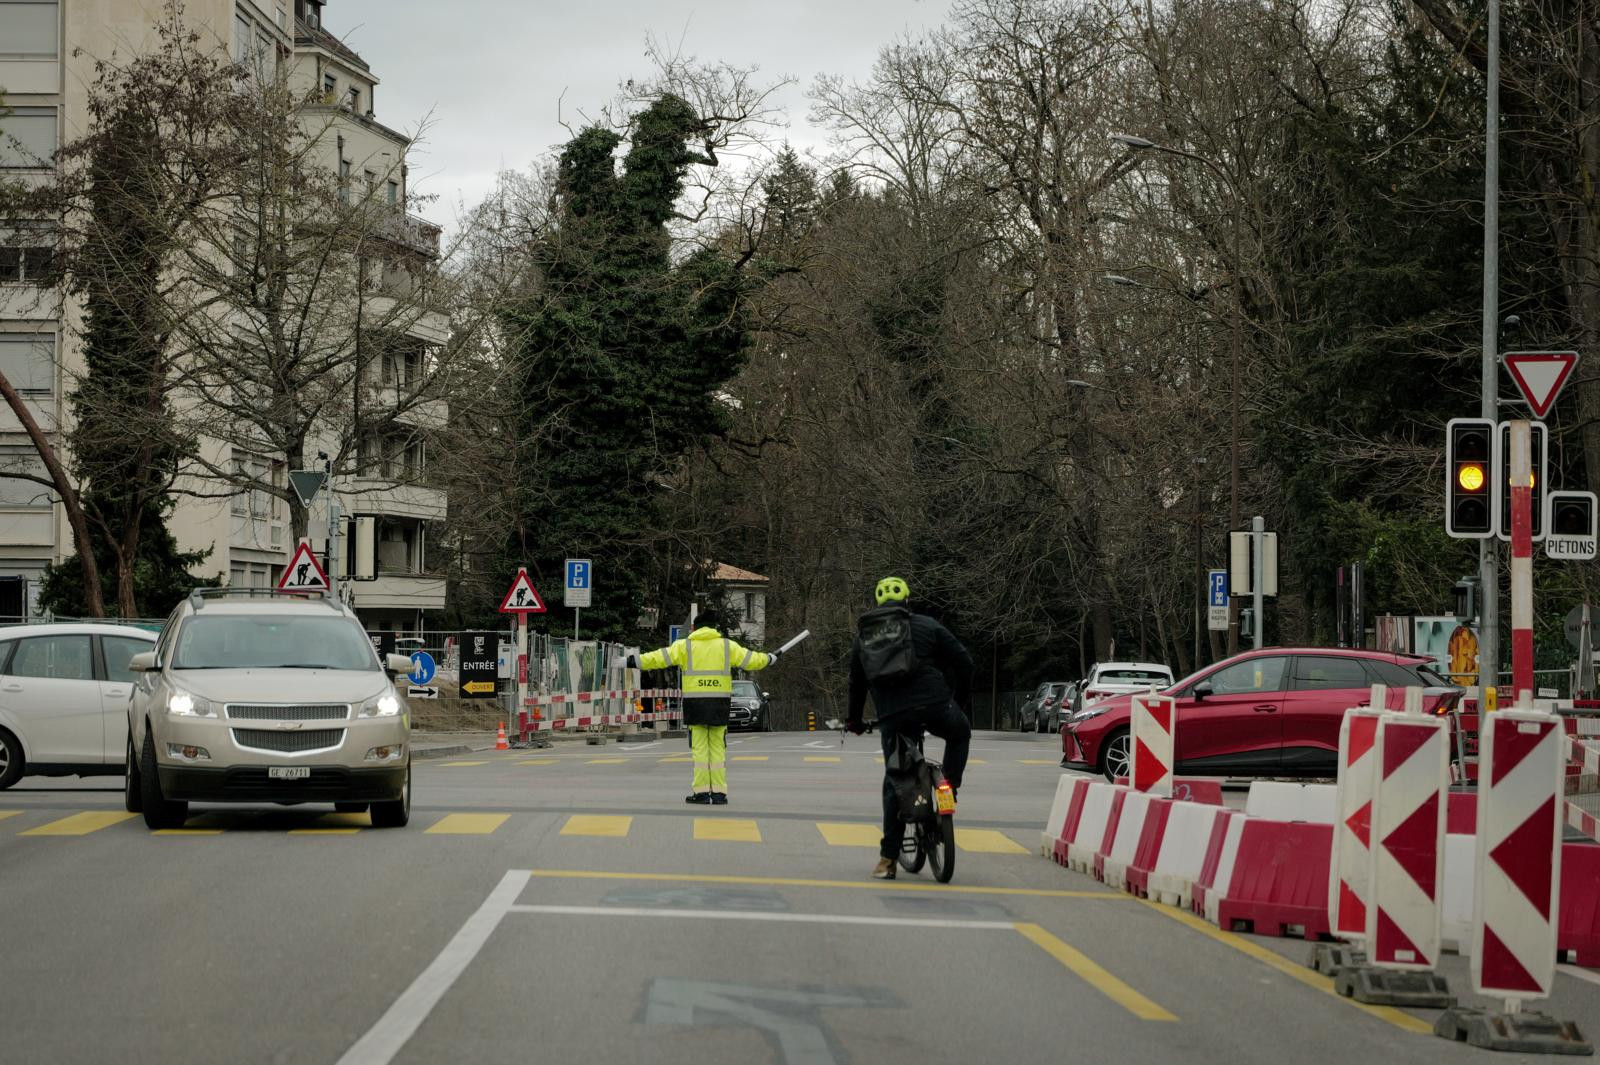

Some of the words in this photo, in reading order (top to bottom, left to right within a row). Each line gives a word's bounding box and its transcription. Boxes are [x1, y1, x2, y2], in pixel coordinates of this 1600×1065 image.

[1547, 538, 1595, 555] PIÉTONS
[574, 563, 583, 577] P
[1216, 575, 1224, 592] P
[463, 660, 495, 670] ENTRÉE
[471, 682, 493, 690] OUVERT
[271, 768, 280, 777] GE
